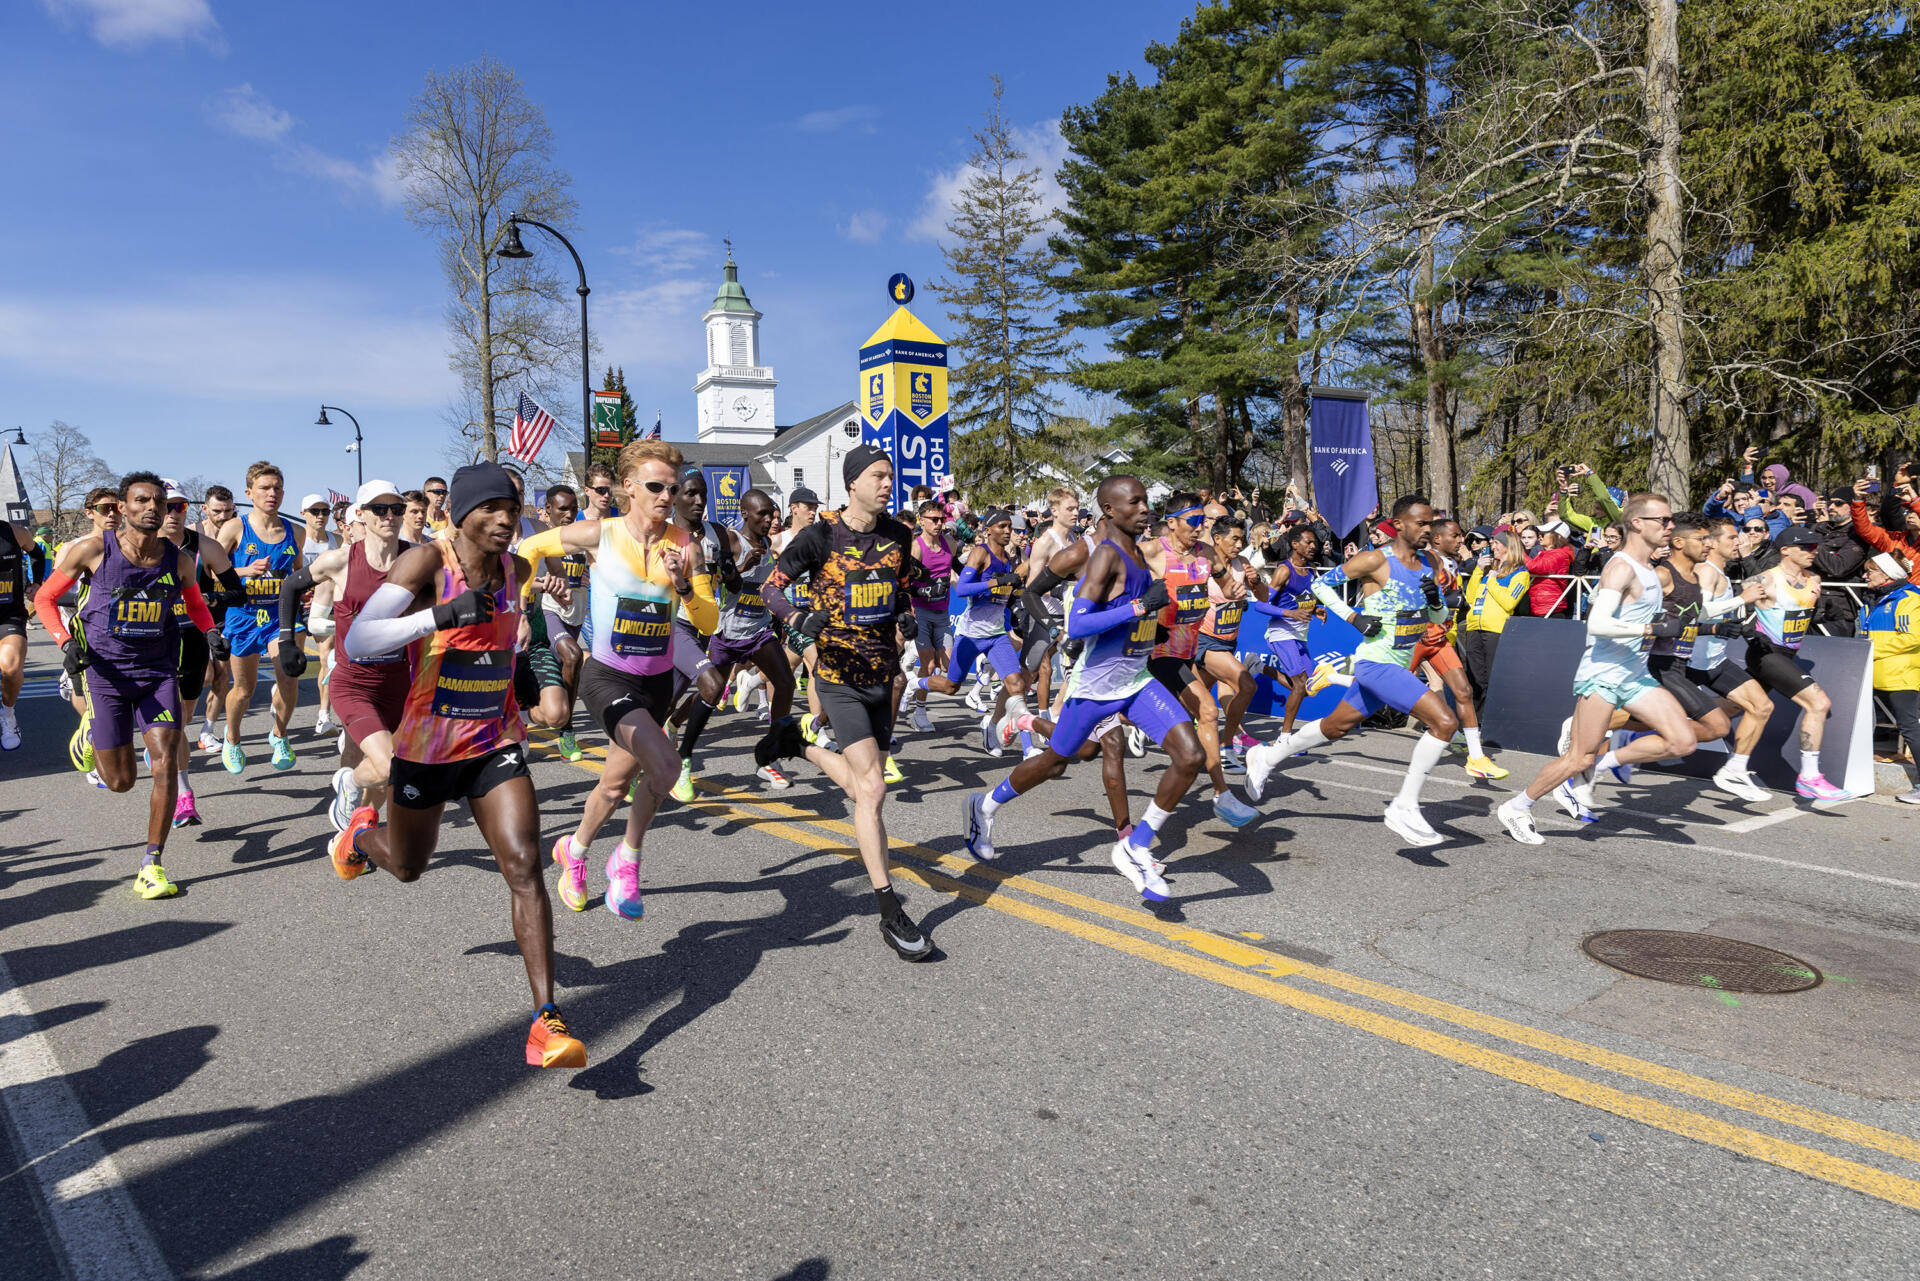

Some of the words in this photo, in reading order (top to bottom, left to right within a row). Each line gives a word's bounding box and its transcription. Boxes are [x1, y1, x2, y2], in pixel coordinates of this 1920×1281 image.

[1313, 446, 1330, 454] BANK
[1338, 447, 1368, 455] AMERICA
[246, 578, 284, 595] SMIT
[851, 581, 893, 608] RUPP
[117, 600, 163, 623] LEMI
[613, 617, 671, 637] LINKLETTER
